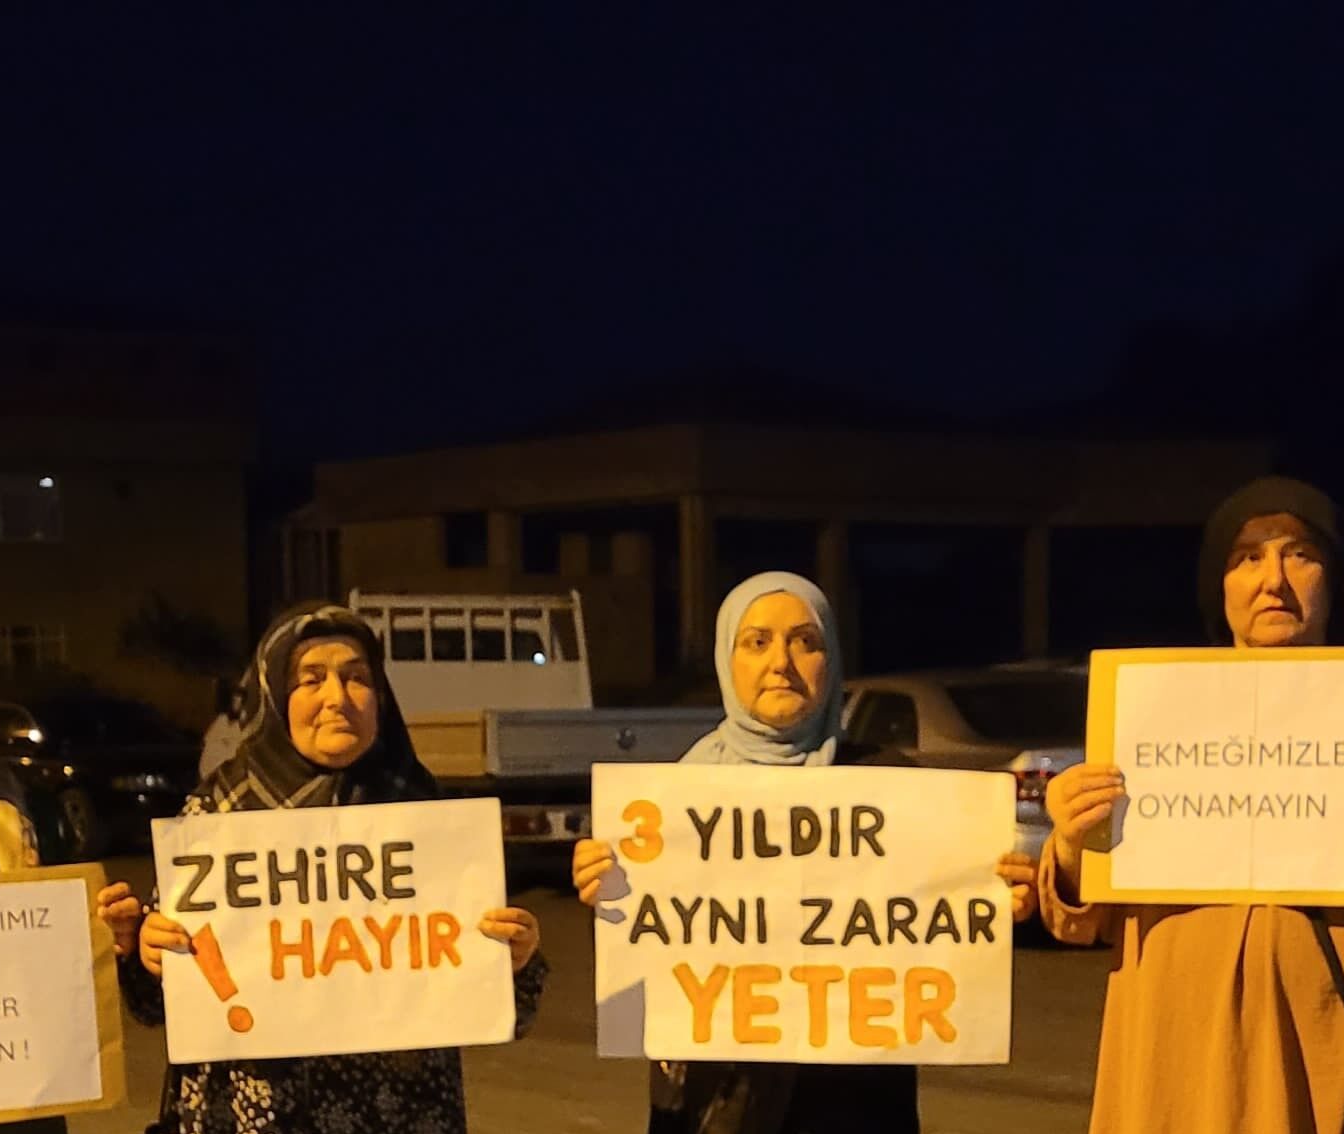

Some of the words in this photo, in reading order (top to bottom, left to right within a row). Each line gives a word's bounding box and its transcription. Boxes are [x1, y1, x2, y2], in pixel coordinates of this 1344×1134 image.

[618, 799, 664, 864] 3
[687, 804, 886, 860] YILDIR
[1138, 792, 1328, 820] OYNAMAYIN
[269, 911, 462, 980] HAYIR
[629, 893, 768, 945] AYNI
[799, 897, 997, 946] ZARAR
[672, 962, 958, 1049] YETER
